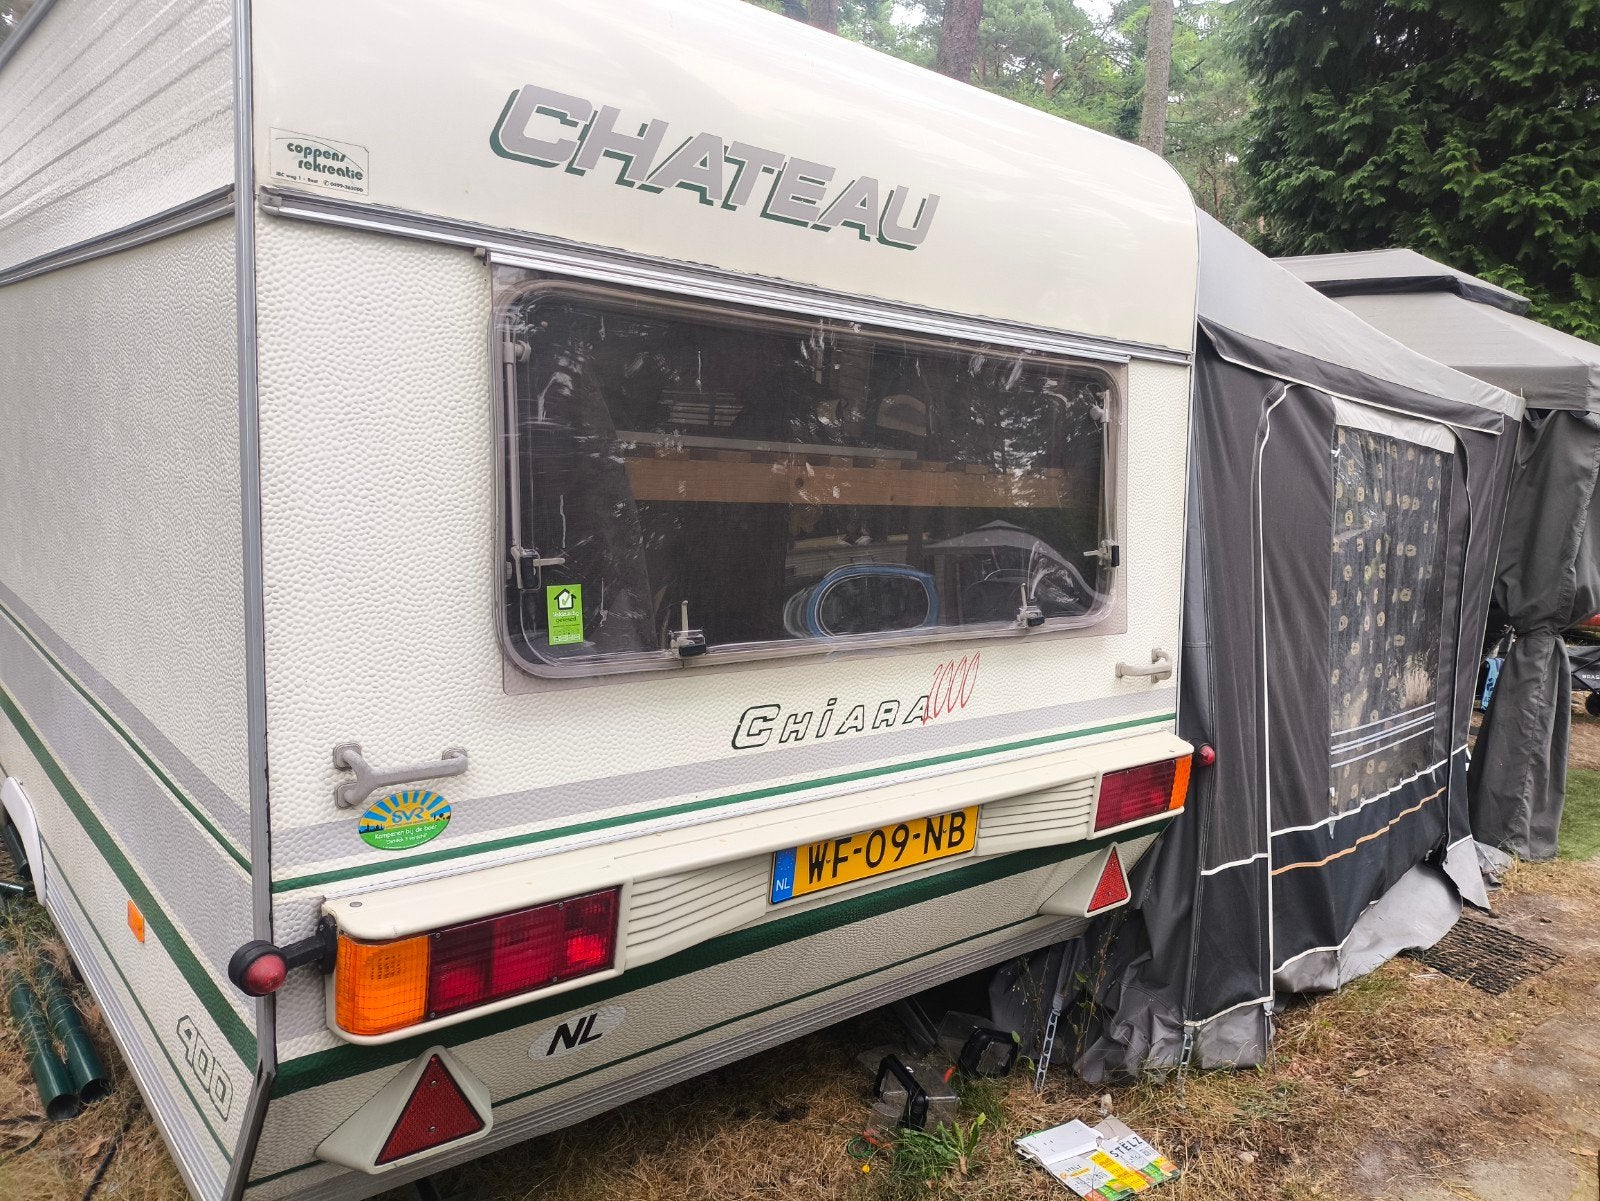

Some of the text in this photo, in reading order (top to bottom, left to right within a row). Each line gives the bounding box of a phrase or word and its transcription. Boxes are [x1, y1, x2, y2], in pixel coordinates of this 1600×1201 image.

[286, 142, 346, 163] coppens
[298, 158, 363, 181] rekreatie
[489, 84, 941, 251] CHATEAU
[923, 650, 981, 725] 2000
[391, 806, 425, 824] SVR
[808, 811, 967, 885] WF-09-NB
[775, 879, 791, 893] NL
[545, 1012, 603, 1057] NL
[176, 1014, 234, 1123] 400
